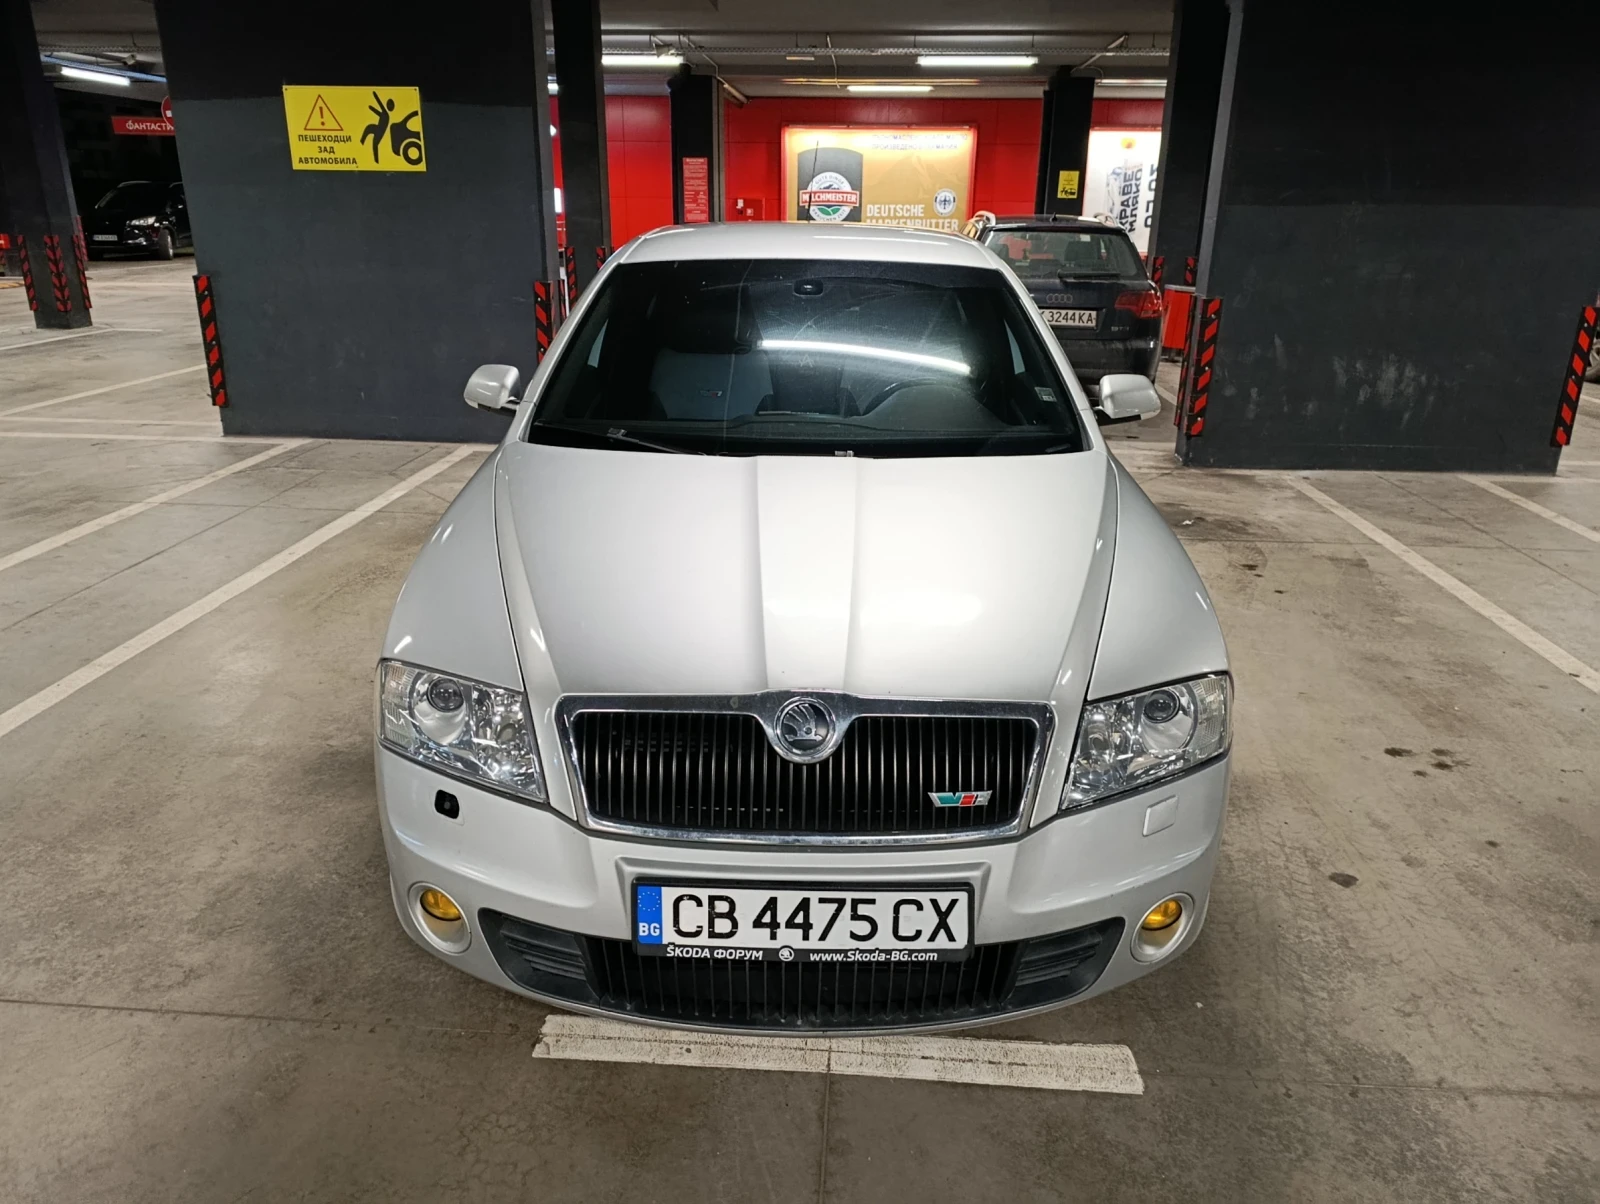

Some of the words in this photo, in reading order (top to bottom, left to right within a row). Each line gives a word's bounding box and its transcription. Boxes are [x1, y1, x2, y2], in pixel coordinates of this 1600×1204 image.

[297, 134, 352, 143] ПЕШЕХОДЦИ
[317, 146, 335, 155] ЗАД
[298, 156, 358, 165] АВТОМОБИЛА
[802, 192, 858, 204] MLCHMEISTER
[866, 204, 925, 217] DEUTSCHE
[1047, 310, 1077, 324] 3244
[1078, 312, 1094, 325] KA
[672, 893, 739, 940] CB
[752, 896, 879, 942] 4475
[891, 897, 960, 943] CX
[638, 922, 660, 936] BG
[666, 944, 711, 959] ŠKODA
[713, 949, 763, 961] ФОРУМ
[809, 951, 939, 961] www.Skoda-BG.com
